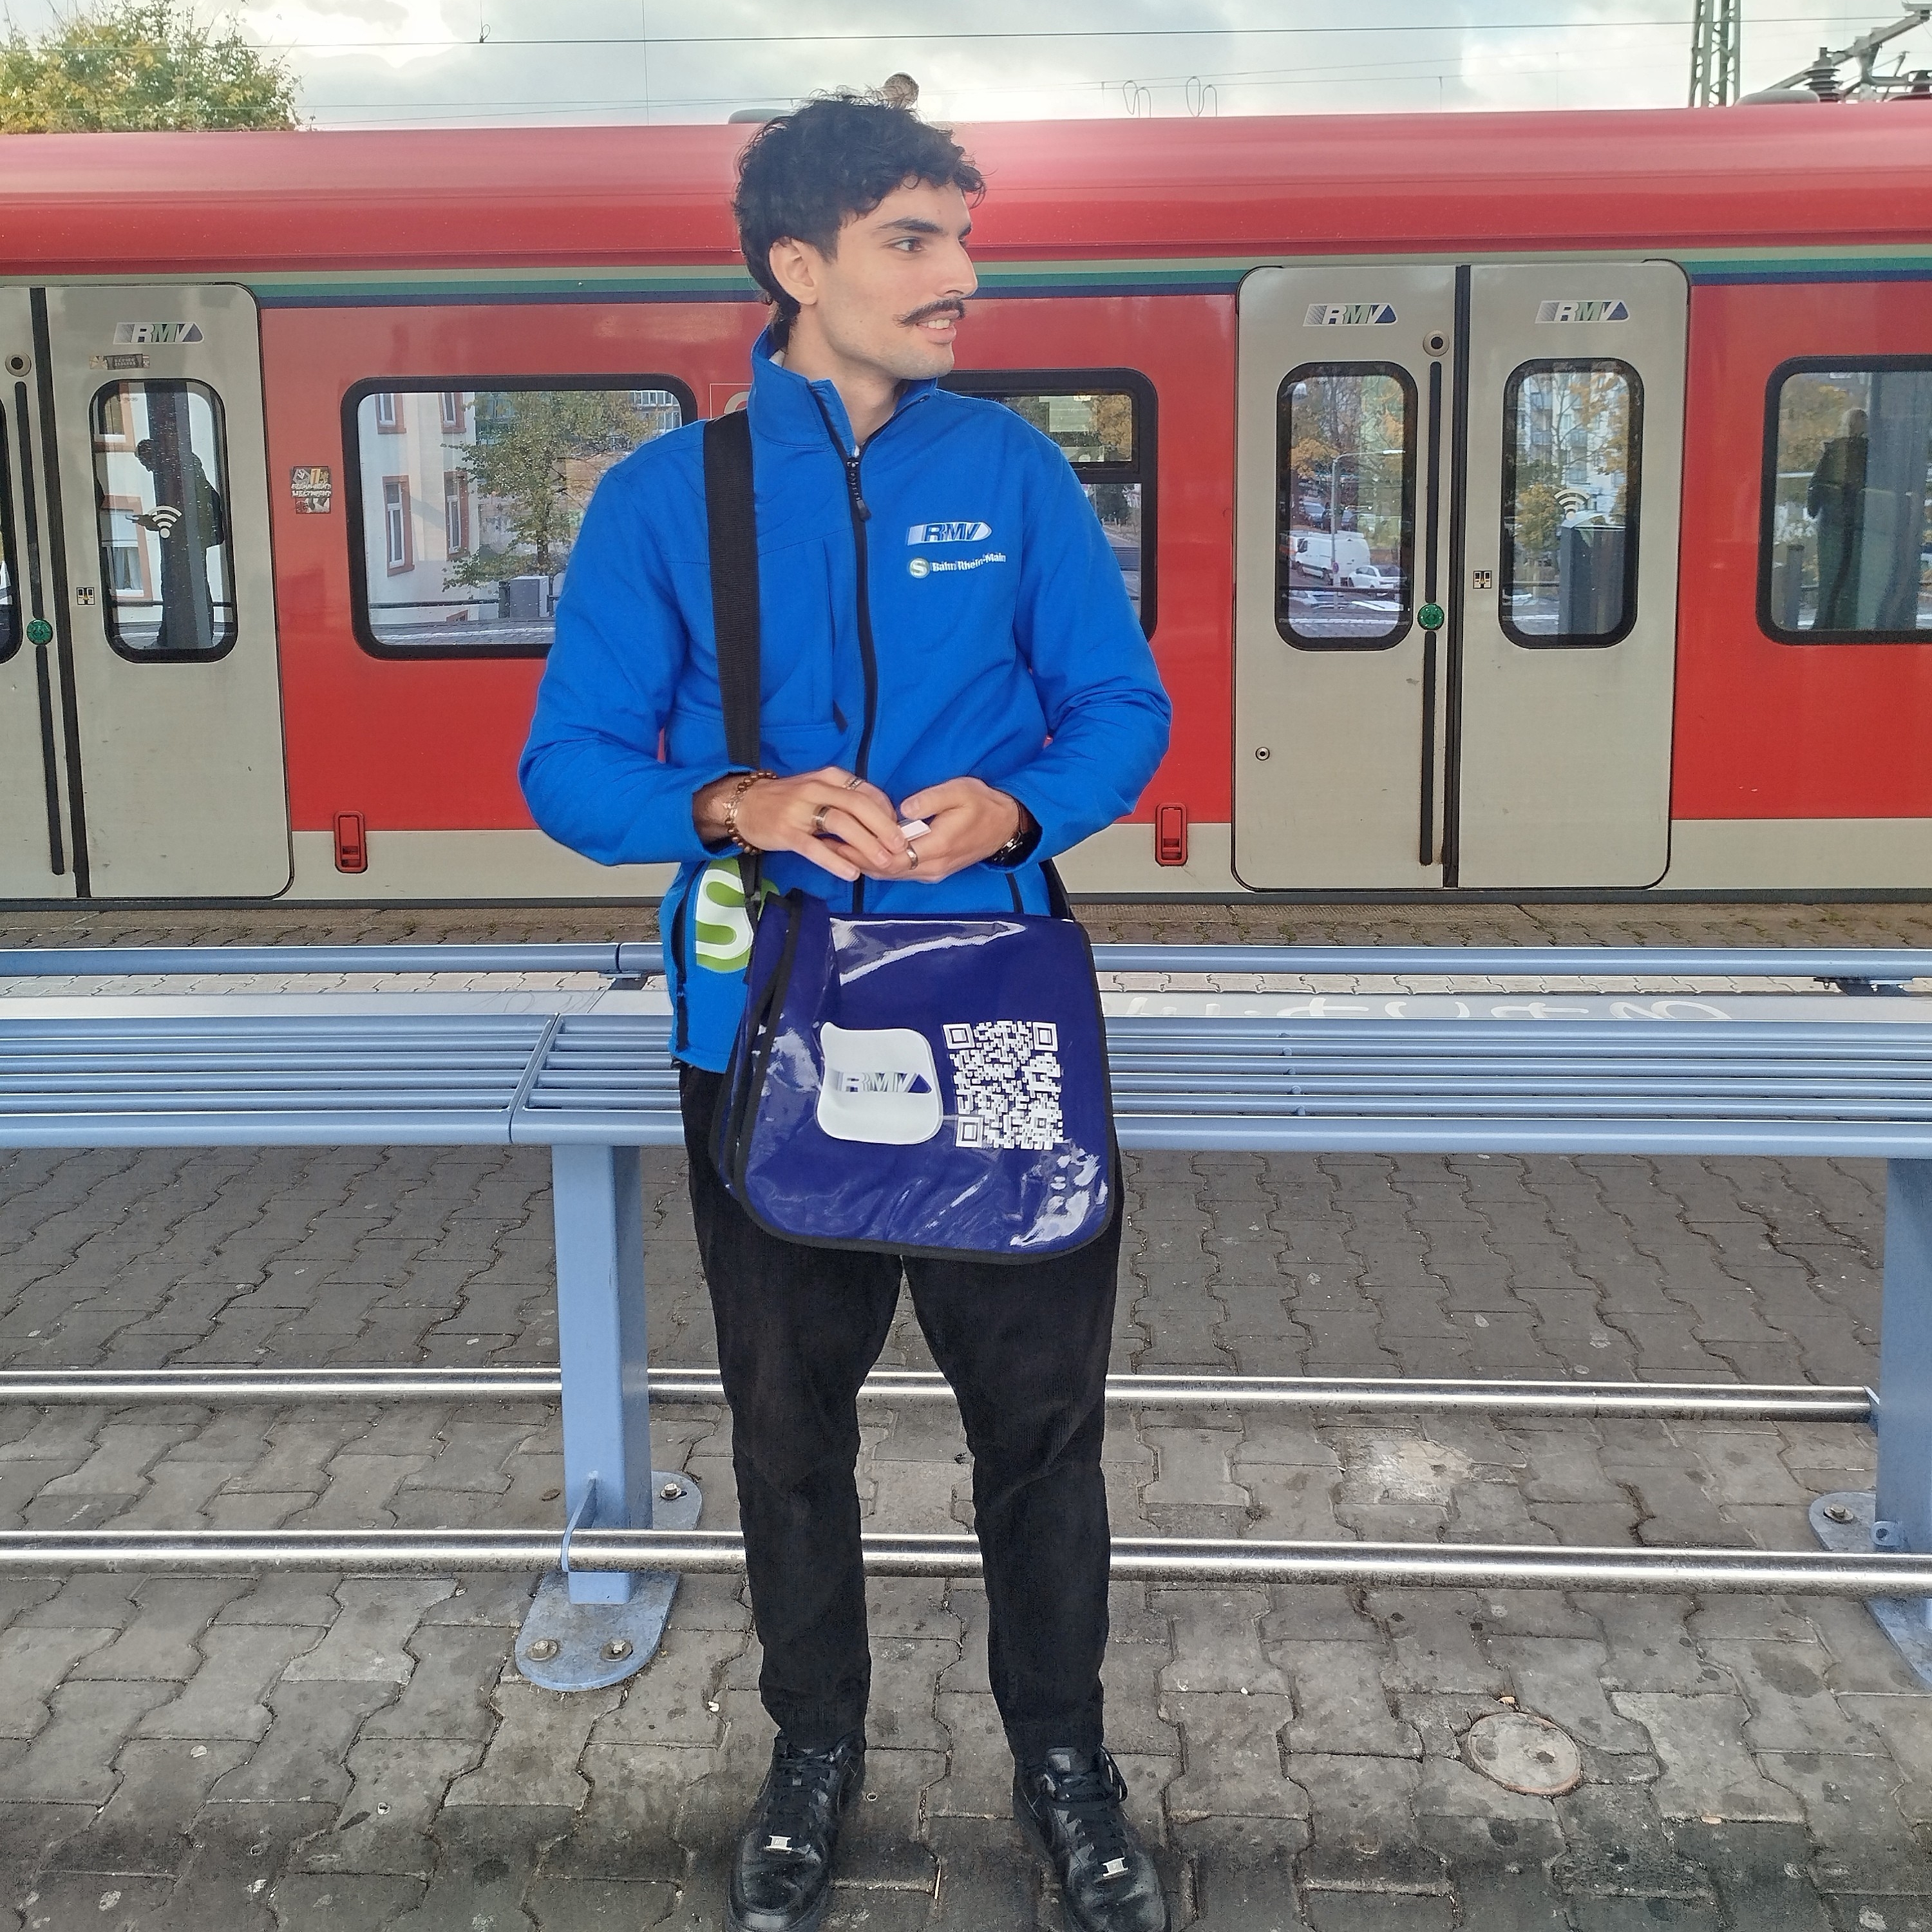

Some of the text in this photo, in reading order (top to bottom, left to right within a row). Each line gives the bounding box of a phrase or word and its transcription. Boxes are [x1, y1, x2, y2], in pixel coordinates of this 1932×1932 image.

[1321, 304, 1389, 325] RMV
[1553, 300, 1622, 322] RMV
[131, 323, 194, 343] RMV
[922, 522, 983, 542] RMV
[911, 558, 929, 578] S
[932, 560, 957, 572] Bahn
[837, 1072, 918, 1094] RMV
